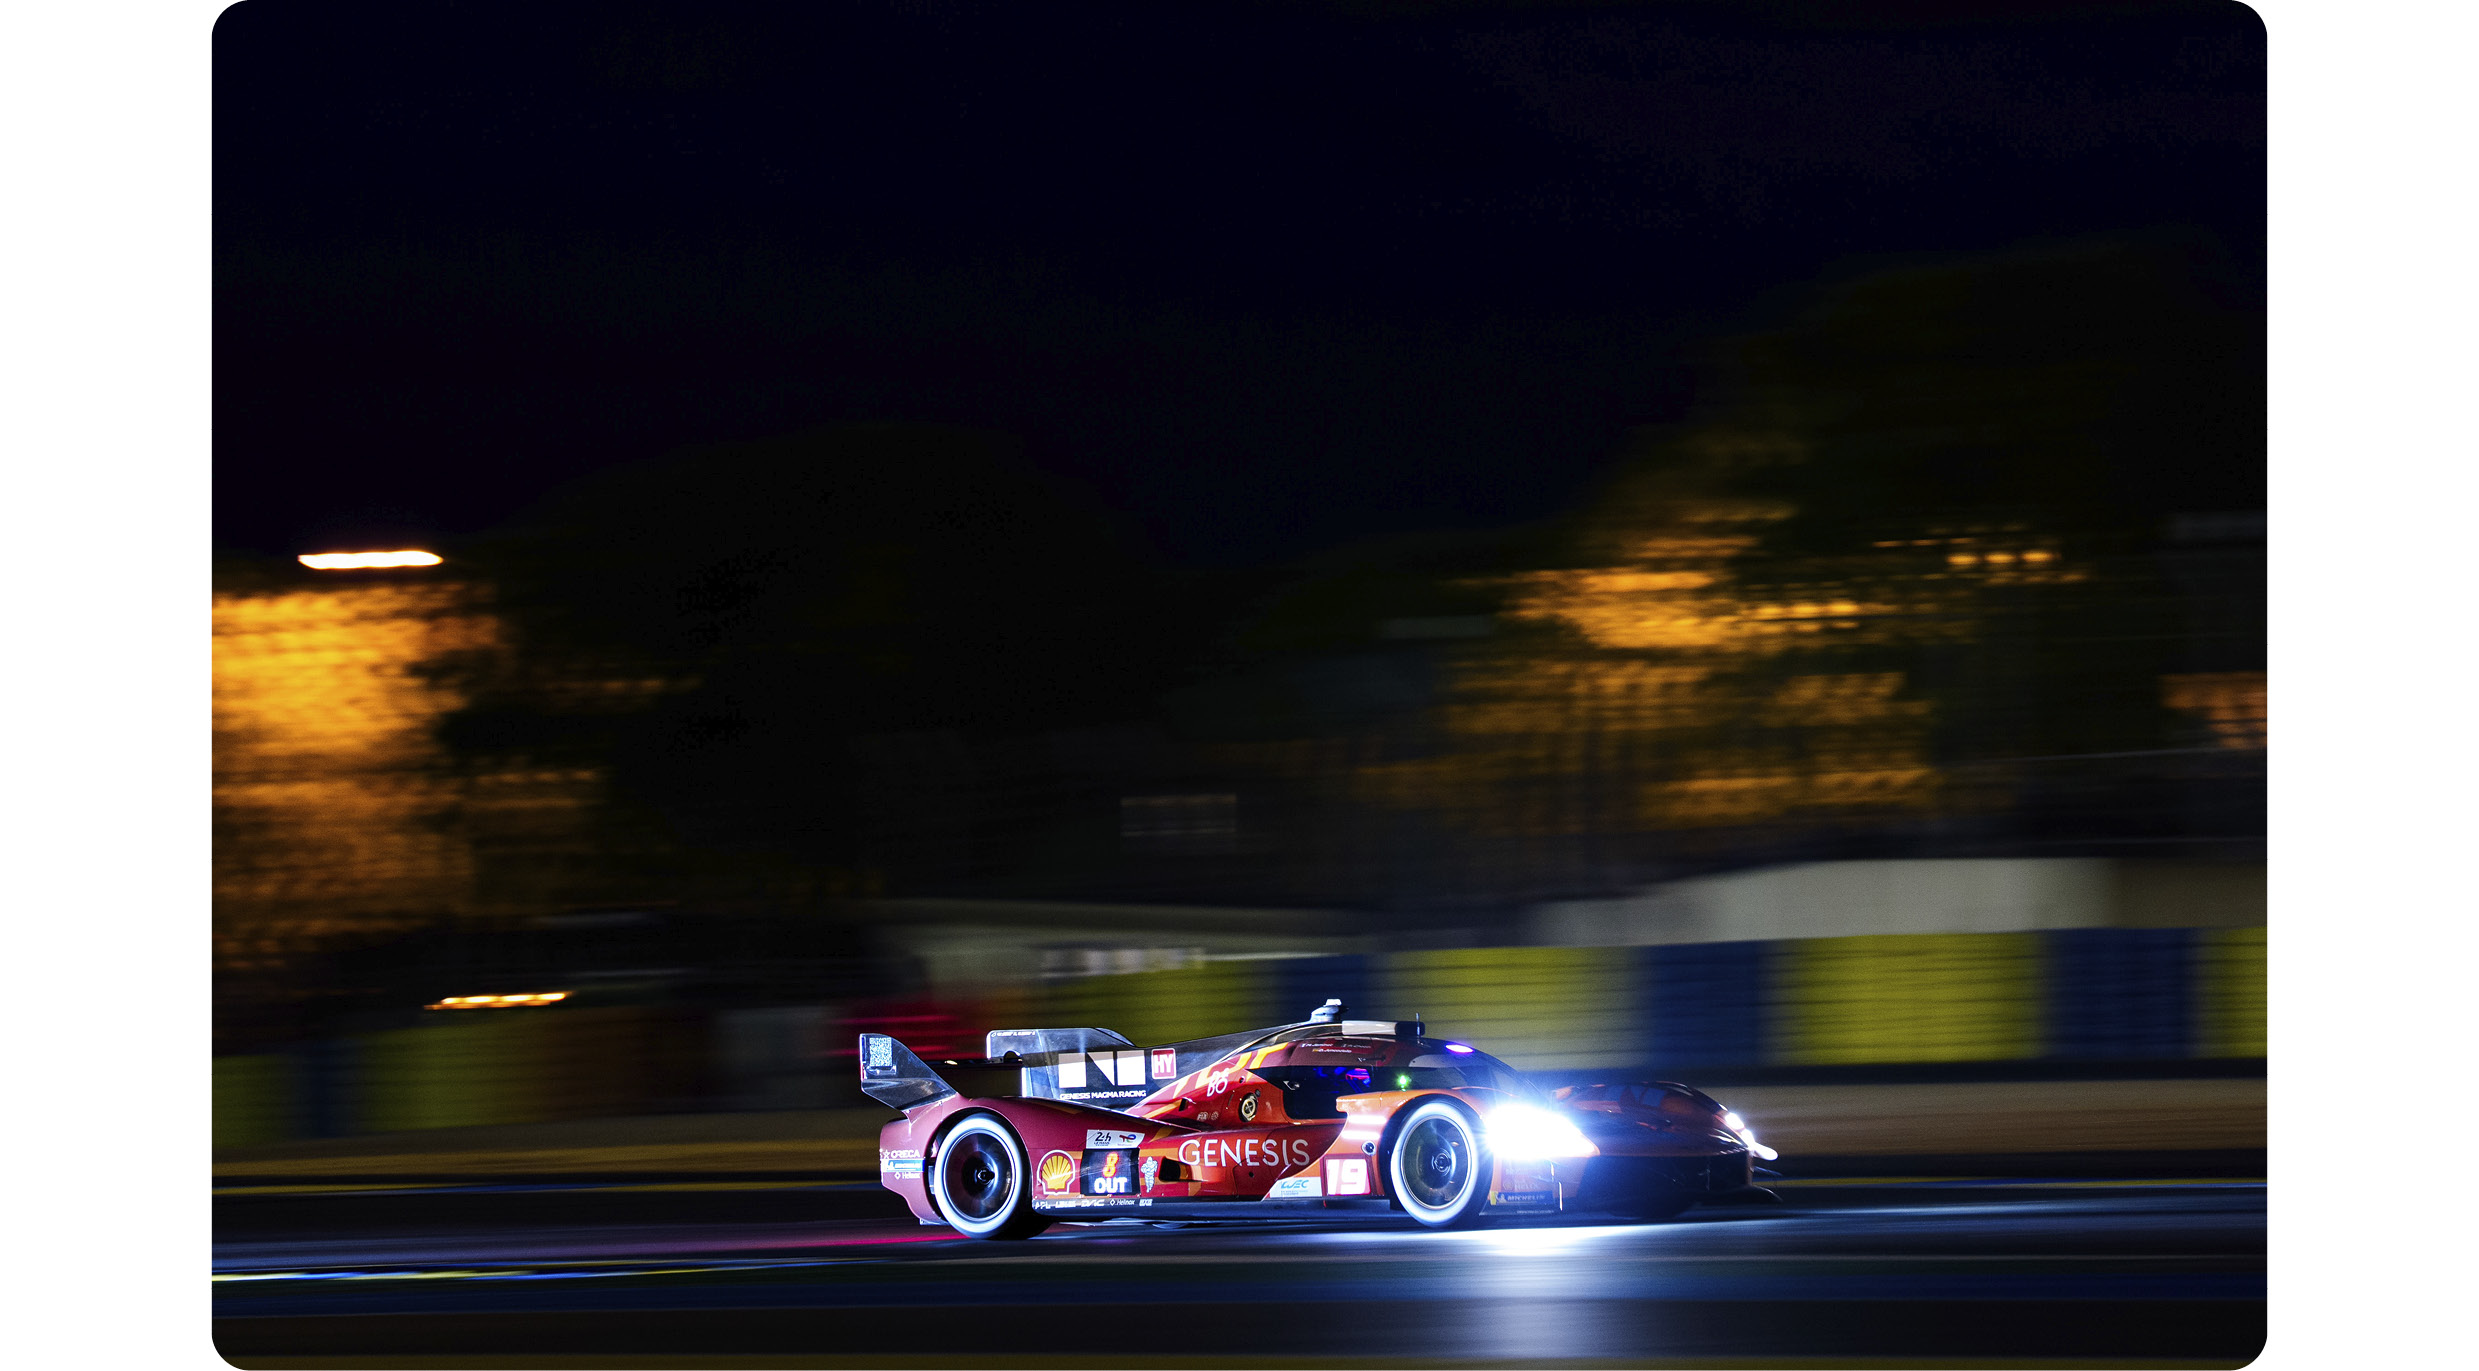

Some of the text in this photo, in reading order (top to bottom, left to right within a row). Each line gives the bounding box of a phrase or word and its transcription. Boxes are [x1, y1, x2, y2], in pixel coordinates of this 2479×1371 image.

[1153, 1053, 1173, 1073] HY
[1059, 1090, 1147, 1100] GENESIS MAGMA RACING
[890, 1149, 921, 1159] ORECA
[1178, 1138, 1310, 1167] GENESIS
[1102, 1151, 1119, 1178] 8
[1093, 1176, 1128, 1194] OUT
[1280, 1179, 1310, 1190] WEC
[1326, 1158, 1367, 1195] 19
